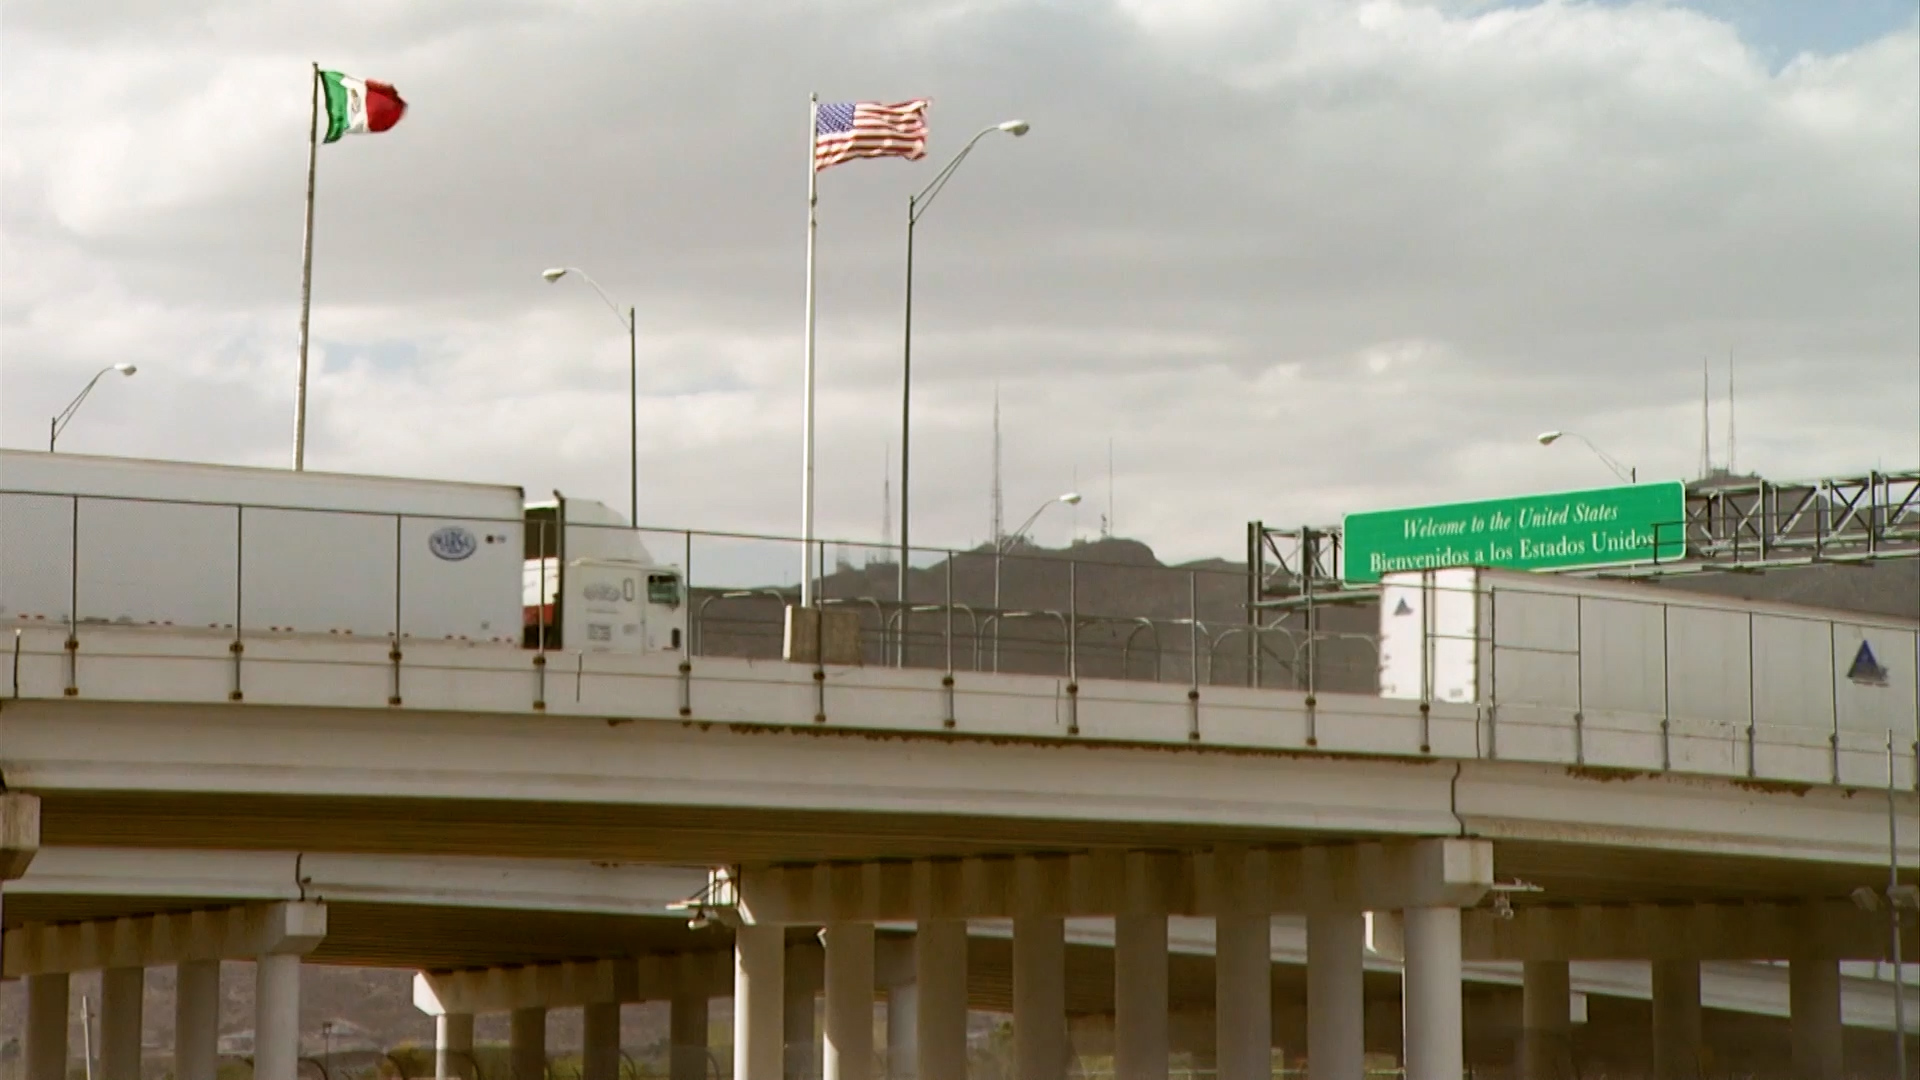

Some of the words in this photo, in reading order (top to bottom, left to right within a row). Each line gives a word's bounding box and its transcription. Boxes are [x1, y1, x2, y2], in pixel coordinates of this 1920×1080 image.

[1404, 517, 1466, 539] Welcome
[1471, 516, 1485, 532] to
[1490, 511, 1511, 530] the
[1519, 504, 1569, 528] United
[1573, 503, 1618, 524] States
[1370, 546, 1469, 572] Bienvenidos
[1475, 549, 1484, 562] a
[1490, 542, 1512, 561] los
[1520, 536, 1585, 560] Estados
[1592, 528, 1655, 553] Unidos
